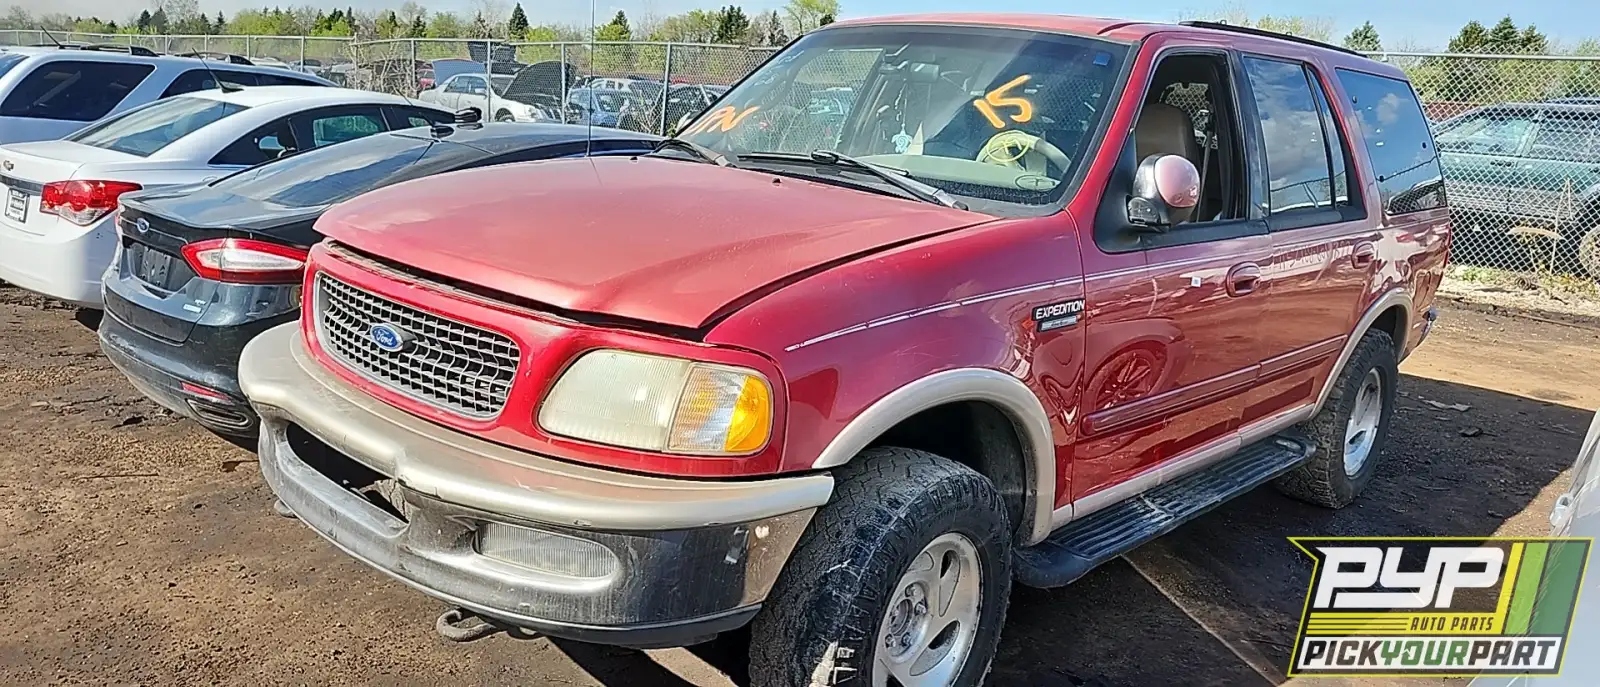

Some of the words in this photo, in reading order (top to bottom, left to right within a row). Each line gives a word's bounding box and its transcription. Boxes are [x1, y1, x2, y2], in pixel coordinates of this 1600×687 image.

[973, 74, 1032, 129] 15
[1035, 299, 1085, 320] EXPEDITION
[373, 328, 395, 346] Ford
